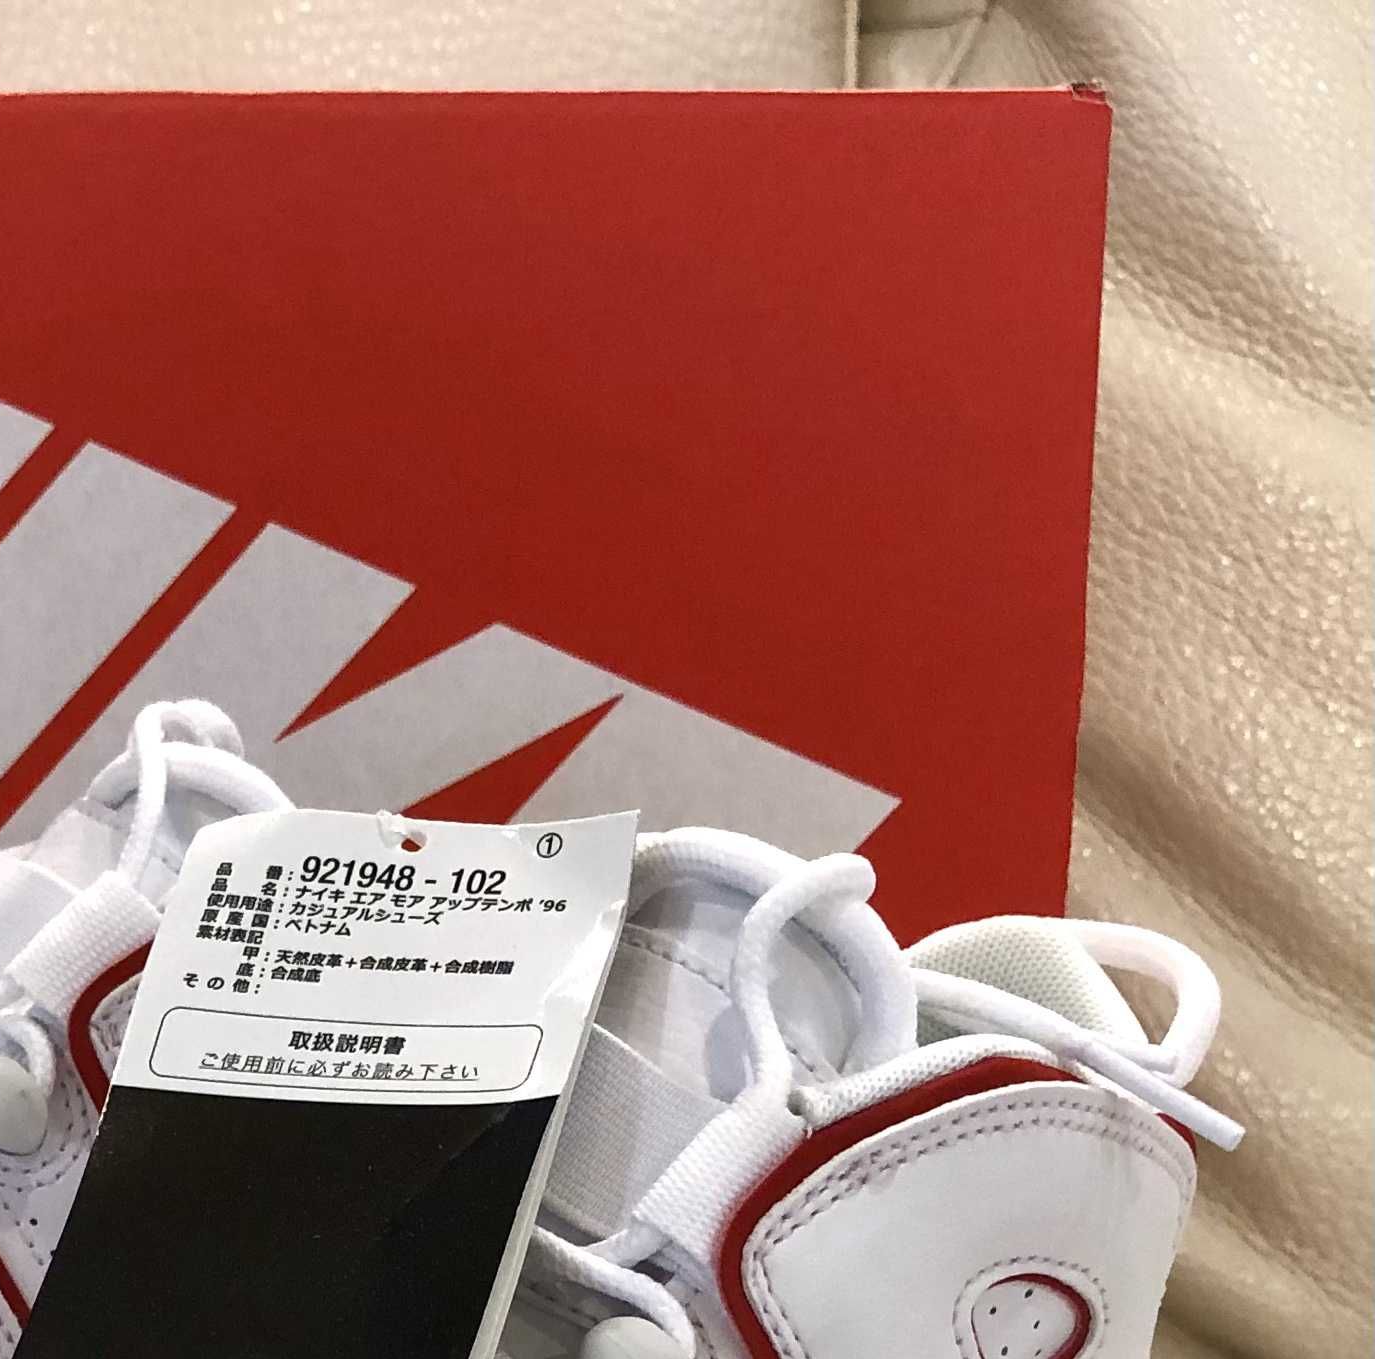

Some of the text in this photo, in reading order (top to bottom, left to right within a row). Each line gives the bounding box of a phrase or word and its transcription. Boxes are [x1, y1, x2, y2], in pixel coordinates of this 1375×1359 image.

[300, 856, 416, 891] 921948
[451, 868, 506, 895] 102
[195, 925, 264, 945] 素材表記
[288, 1030, 406, 1055] 取扱説明書
[199, 1052, 481, 1081] ご使用前に必ずお読み下さい
